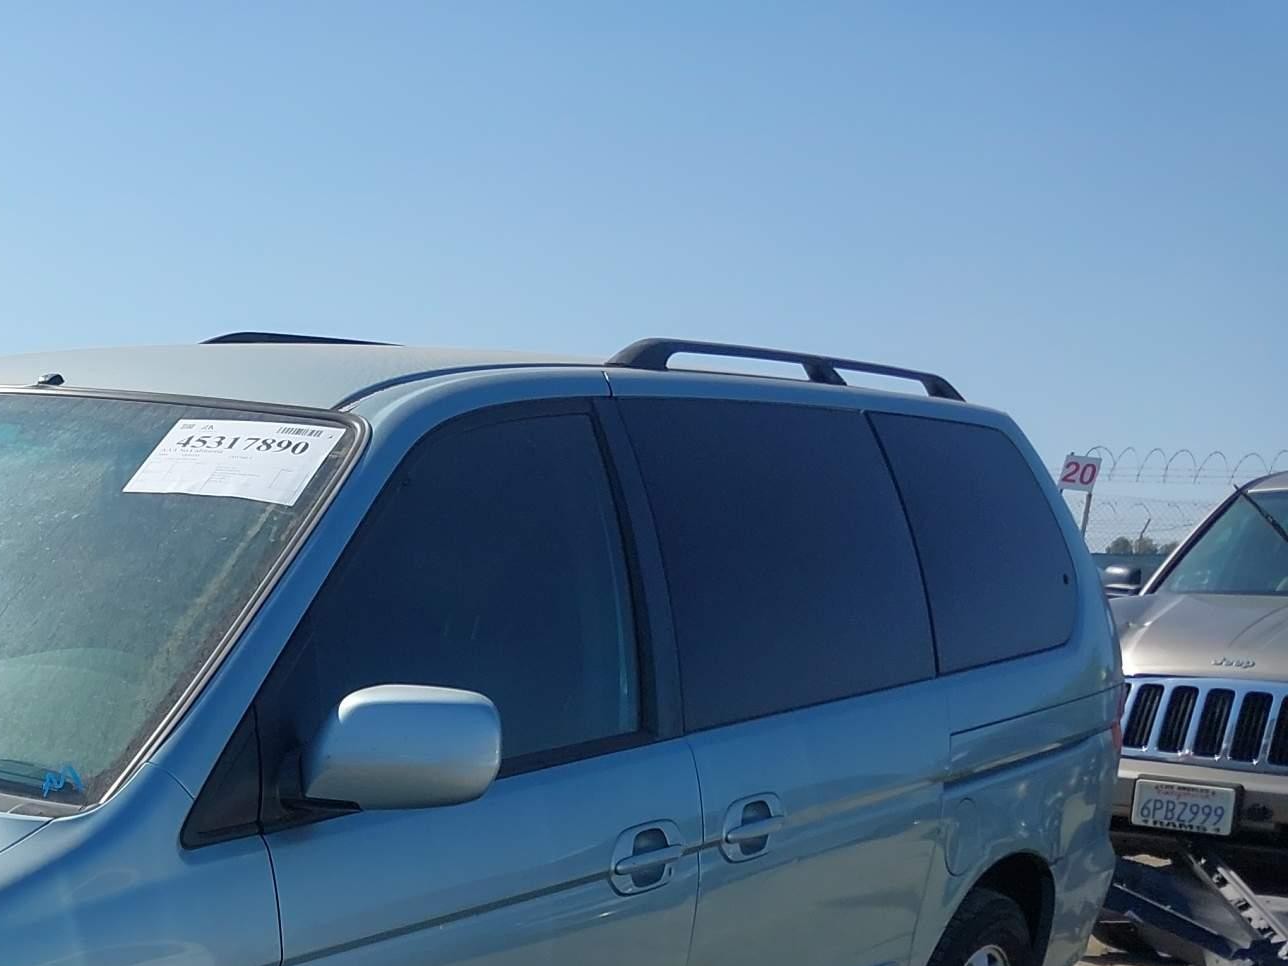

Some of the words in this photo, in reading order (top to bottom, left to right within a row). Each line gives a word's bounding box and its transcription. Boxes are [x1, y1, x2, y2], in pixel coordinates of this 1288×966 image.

[175, 434, 310, 456] 45317890
[1061, 461, 1097, 485] 20
[1210, 656, 1256, 669] Jeep
[1140, 799, 1225, 826] 6PBZ999
